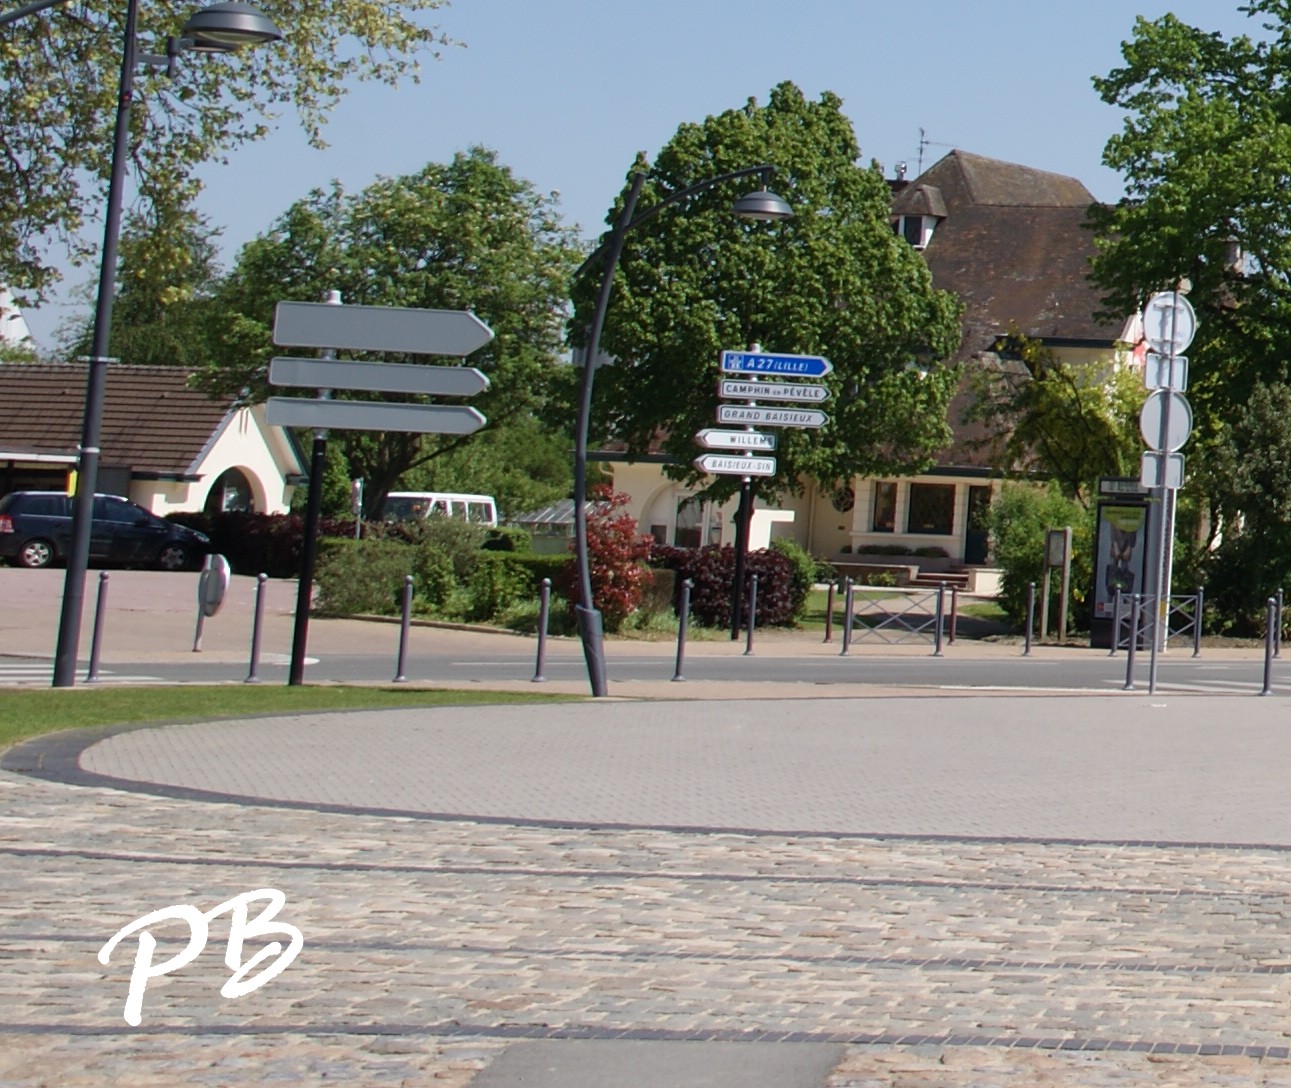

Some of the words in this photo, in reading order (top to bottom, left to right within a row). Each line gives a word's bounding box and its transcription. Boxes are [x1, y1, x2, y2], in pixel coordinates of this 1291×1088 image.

[726, 384, 770, 394] CAMPHIN
[724, 410, 760, 420] GRAND
[765, 412, 813, 423] BAISIEUX
[730, 435, 773, 445] WILLEMS
